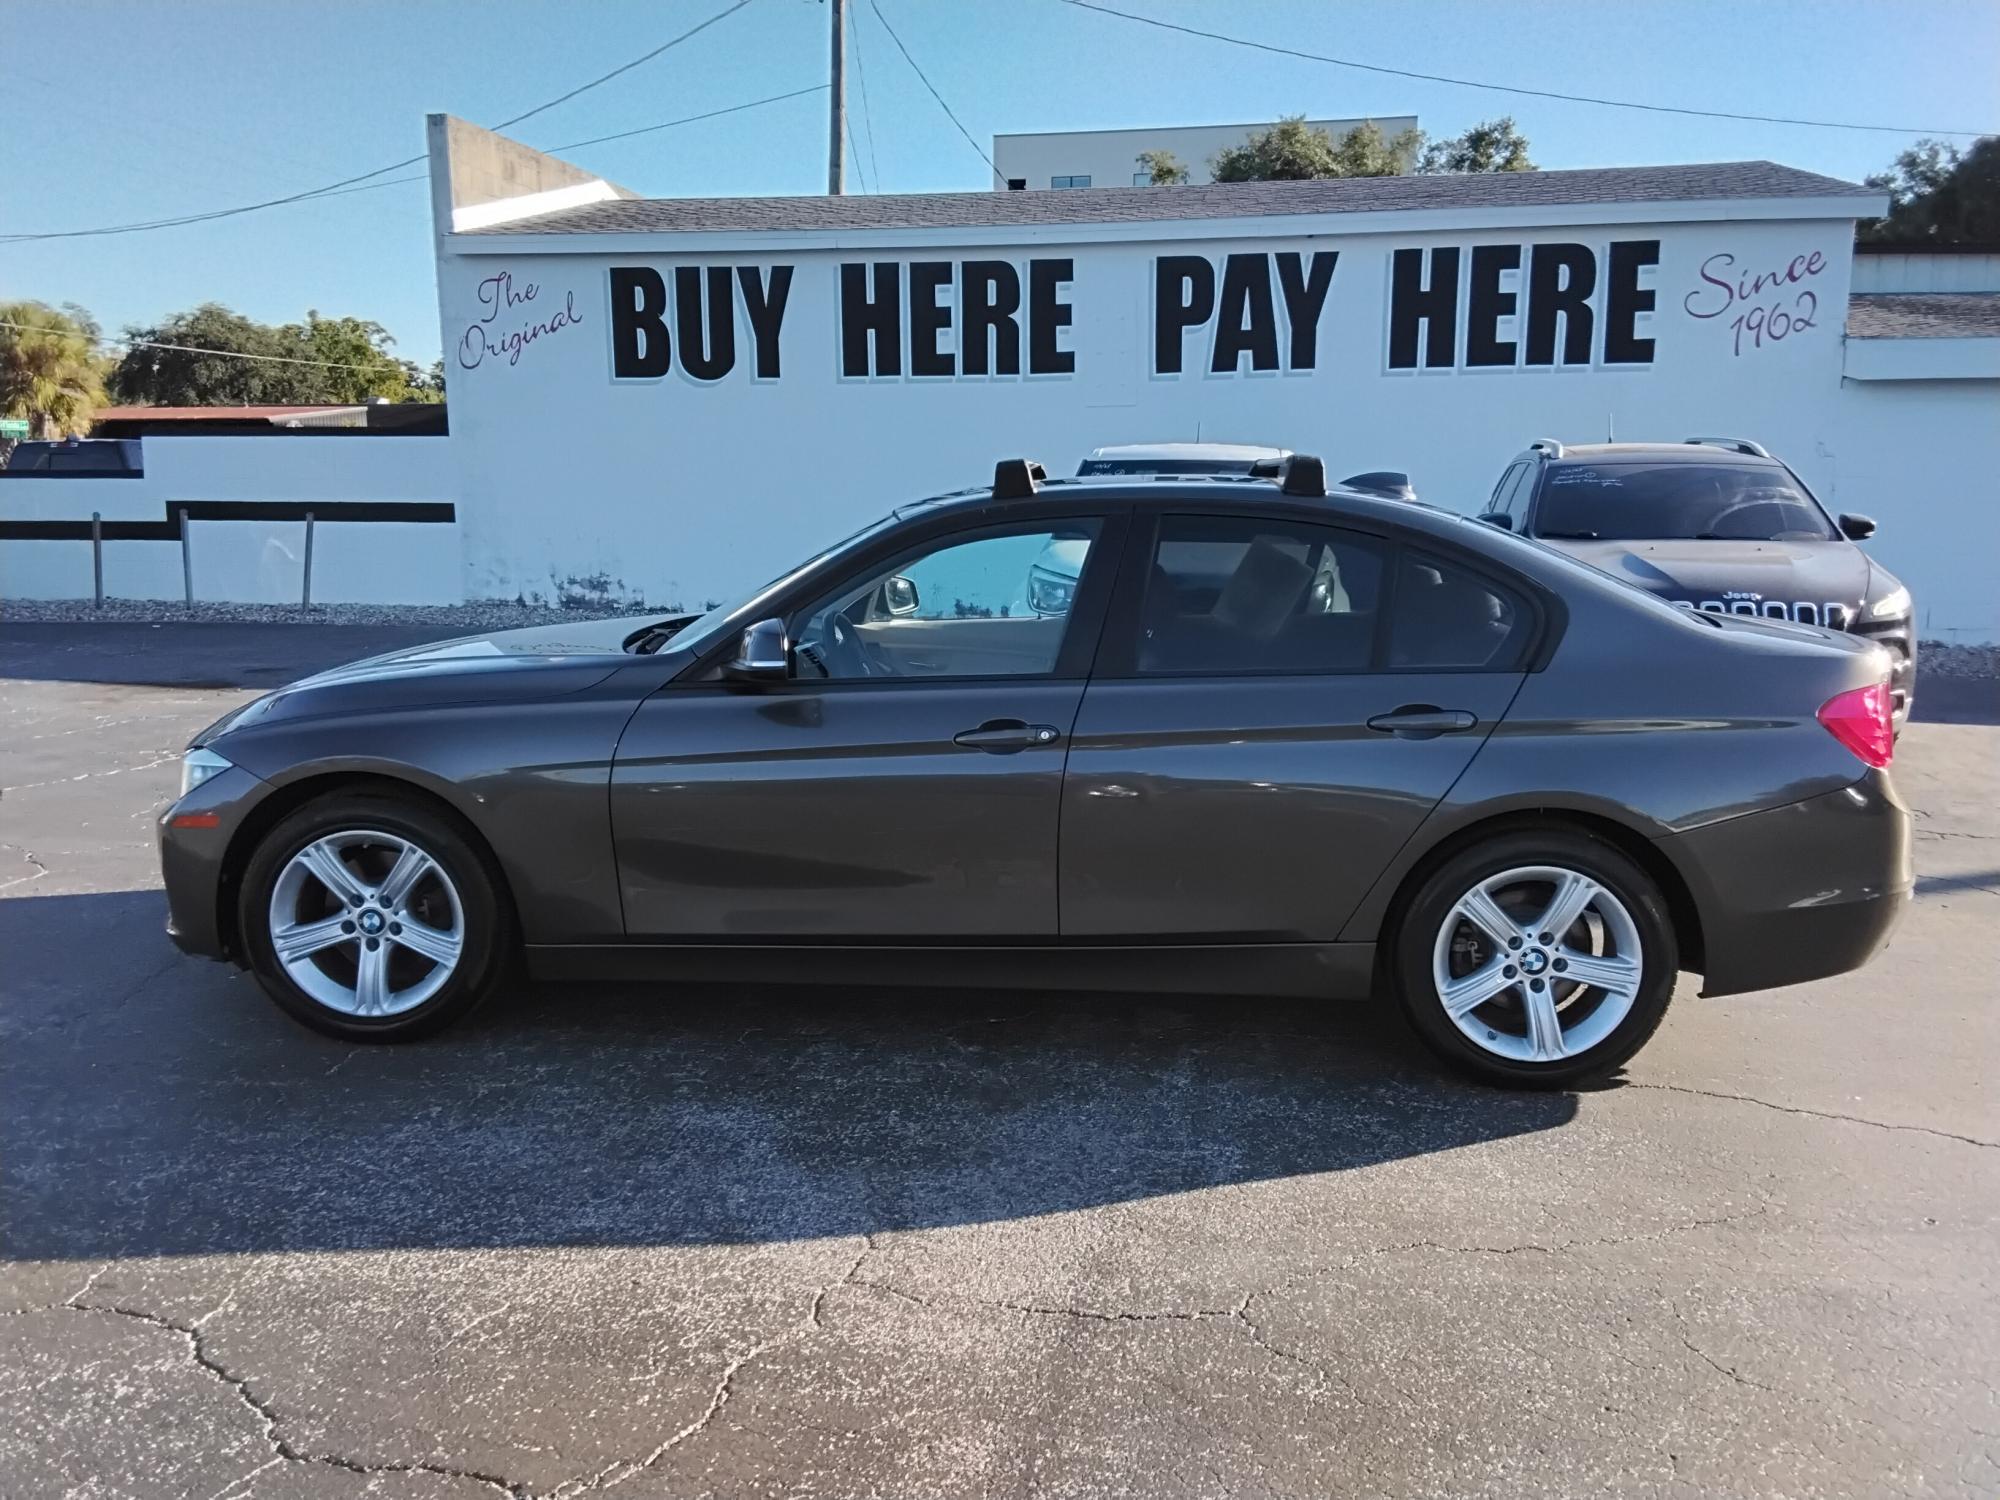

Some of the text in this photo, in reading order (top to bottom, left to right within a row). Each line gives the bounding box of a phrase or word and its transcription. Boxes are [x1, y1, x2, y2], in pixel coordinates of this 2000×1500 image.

[477, 271, 540, 323] The
[608, 240, 1660, 381] BUY HERE PAY HERE
[1683, 250, 1828, 319] Since
[457, 290, 583, 370] Original
[1730, 290, 1818, 357] 1962
